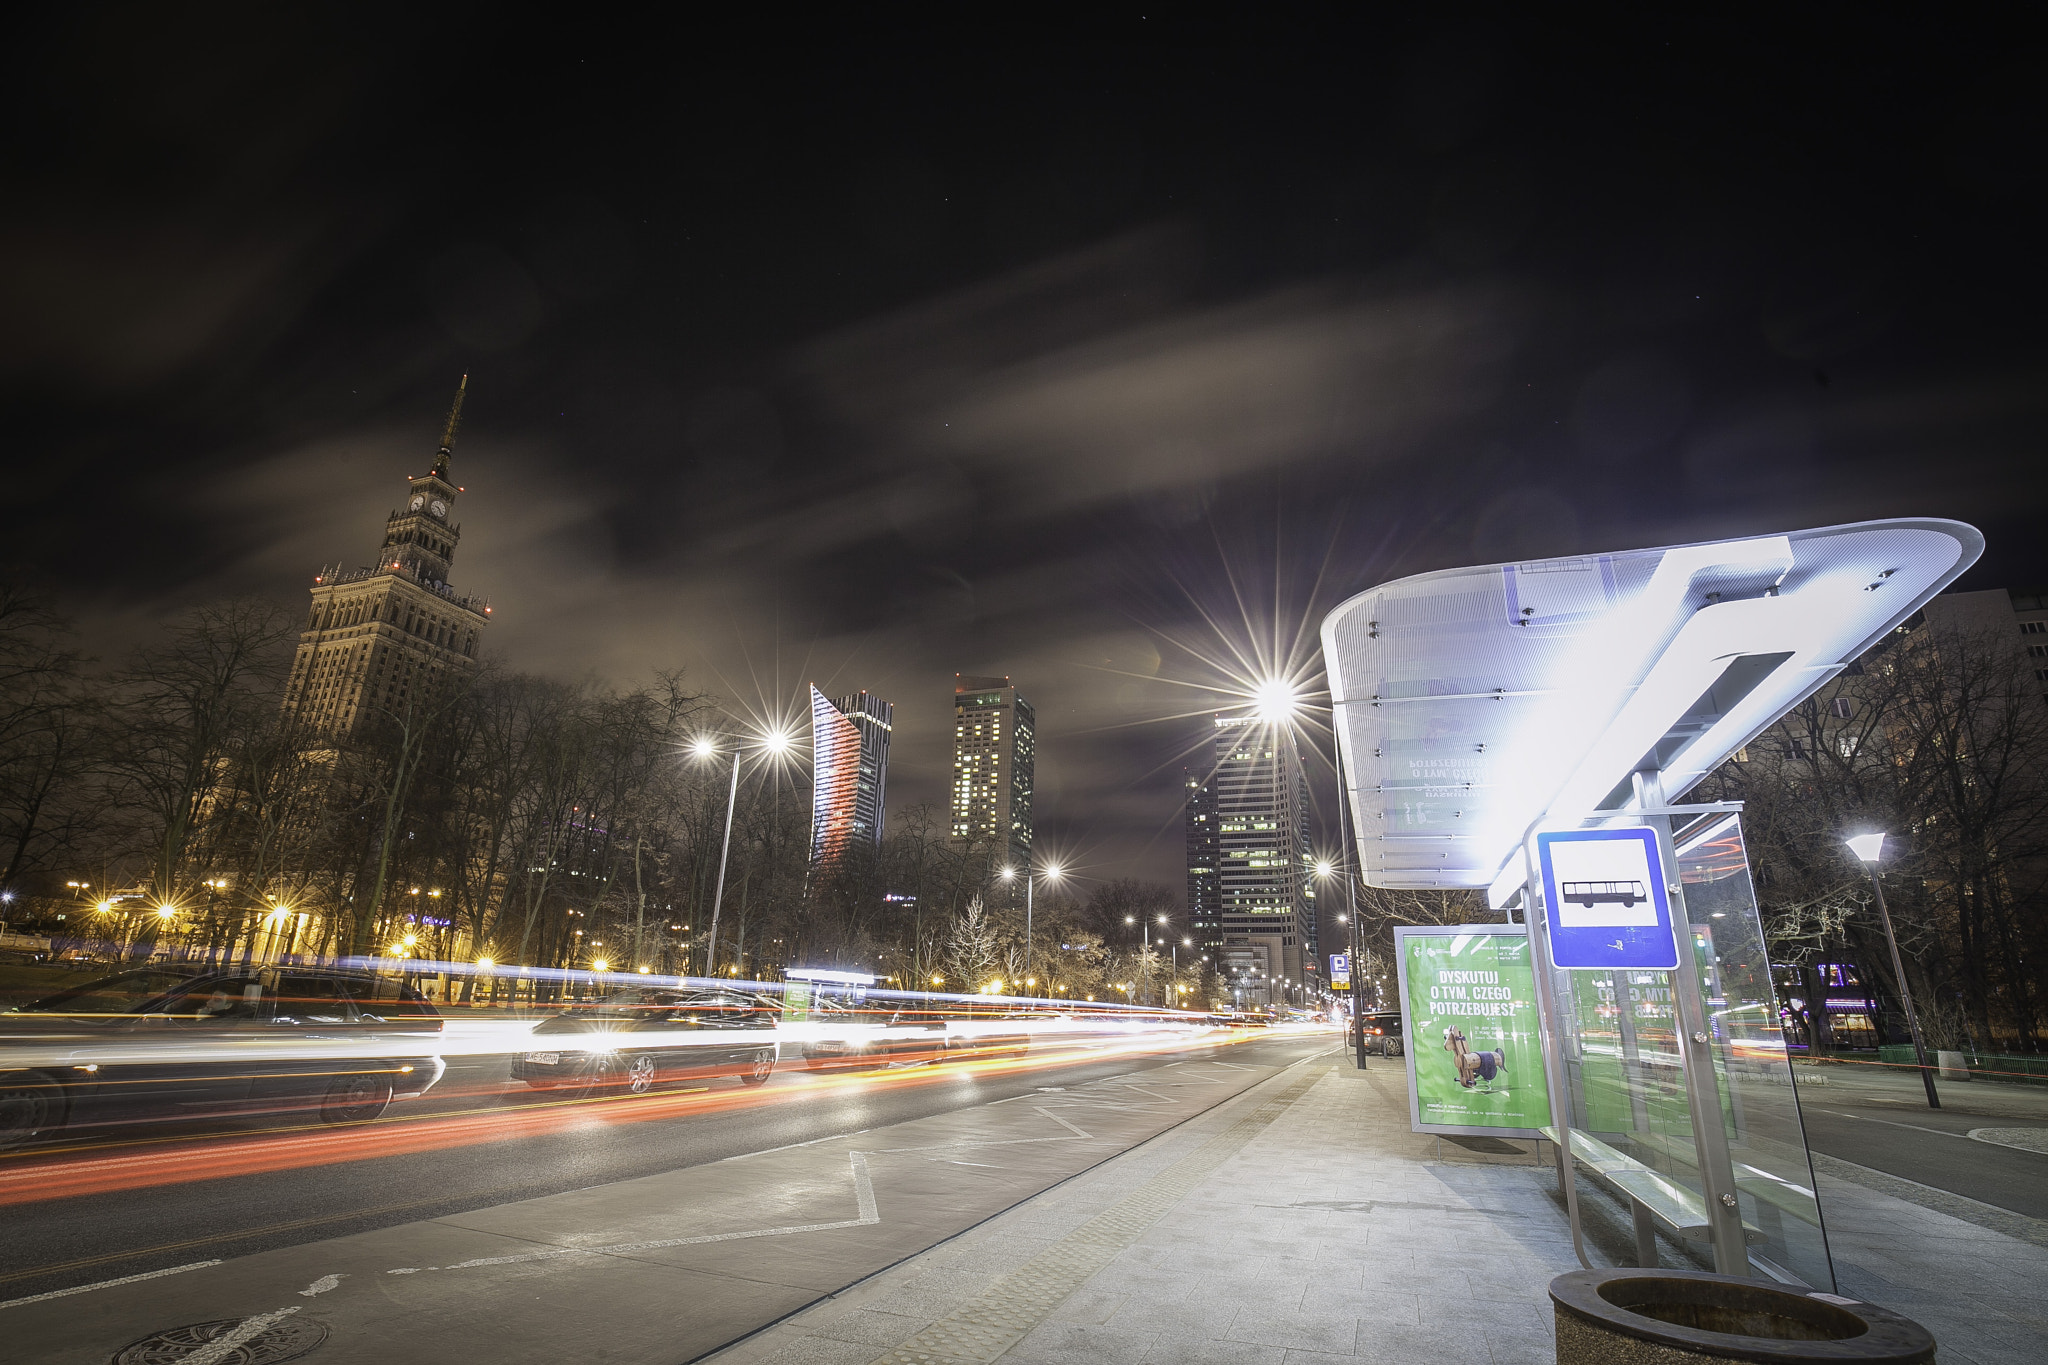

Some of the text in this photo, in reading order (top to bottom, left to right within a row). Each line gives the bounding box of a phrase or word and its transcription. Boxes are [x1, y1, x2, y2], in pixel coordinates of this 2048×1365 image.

[1333, 956, 1346, 972] P
[1439, 970, 1499, 985] DYSKUTUJ
[1430, 986, 1512, 1001] O TYM, CZEGO
[1429, 1002, 1517, 1018] POTRZEBUJESZ
